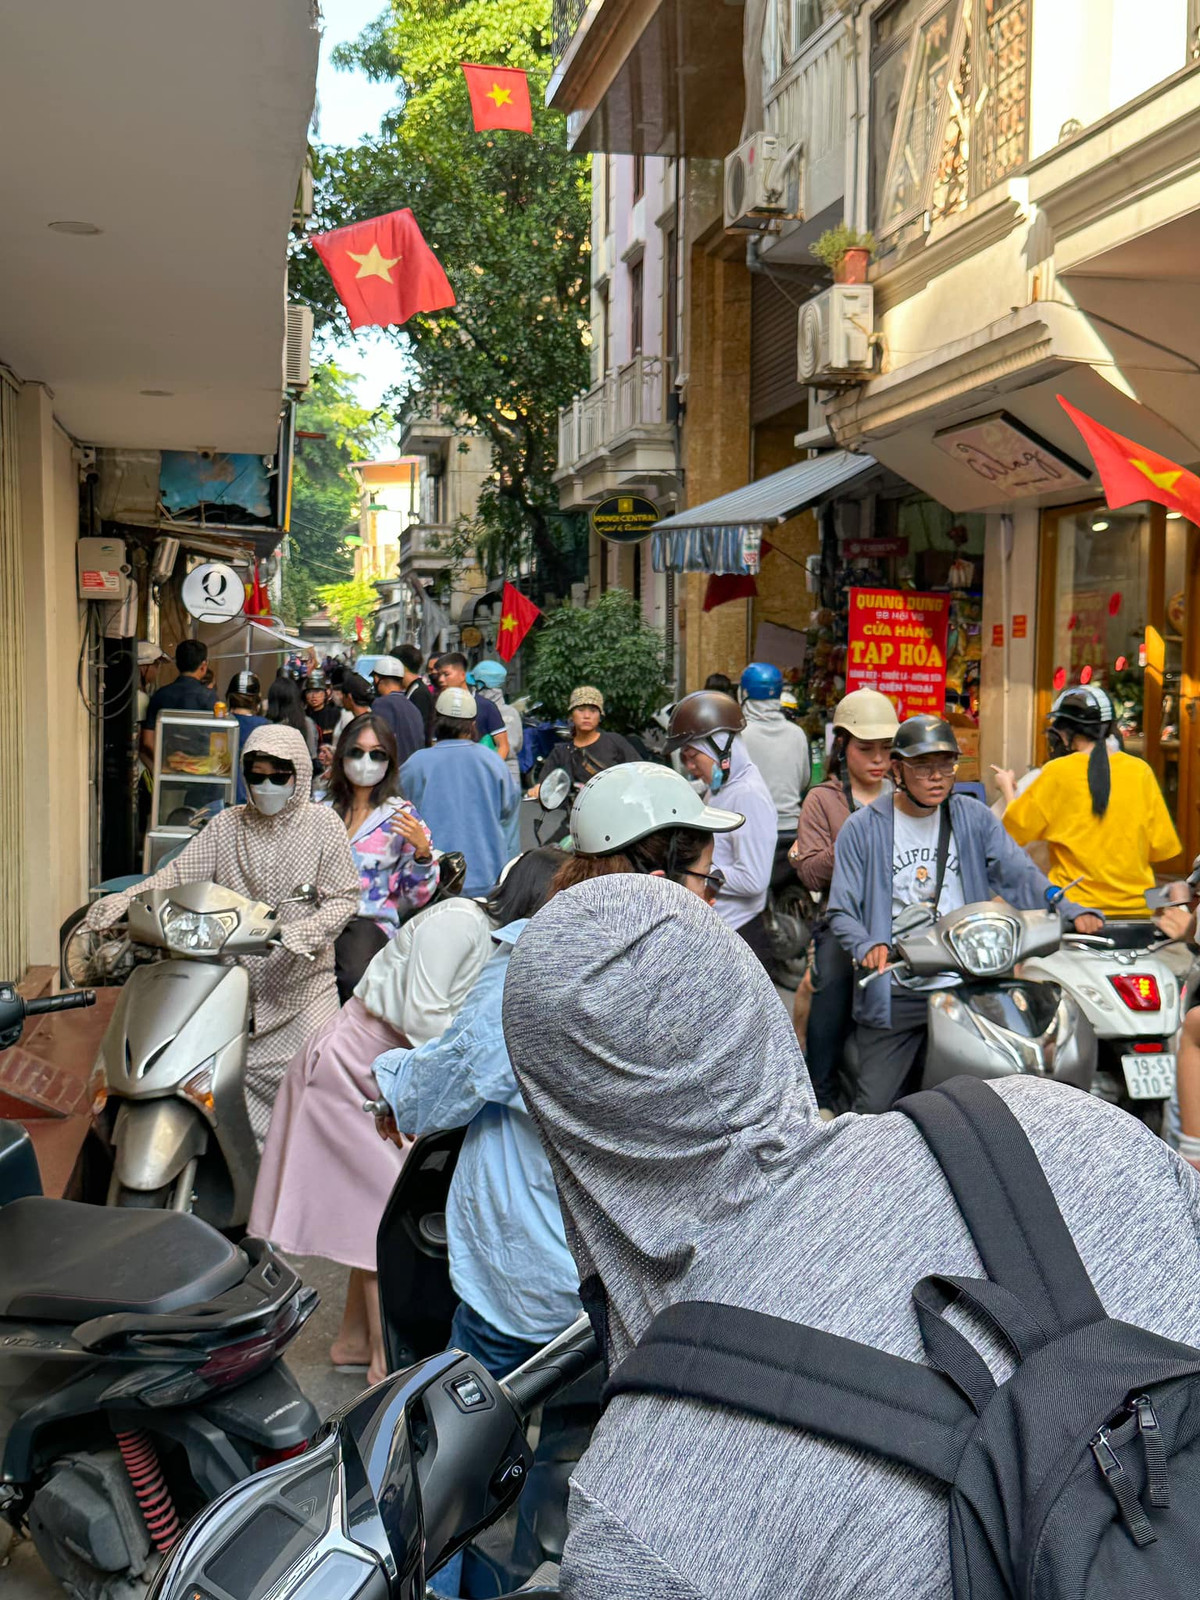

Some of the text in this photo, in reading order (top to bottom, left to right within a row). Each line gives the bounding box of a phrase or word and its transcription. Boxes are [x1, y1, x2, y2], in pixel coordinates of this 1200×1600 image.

[620, 514, 658, 522] CENTRAL
[201, 570, 226, 607] Q
[856, 594, 903, 611] QUANG
[863, 621, 892, 637] CỬA
[850, 639, 943, 671] TẠP HÓA
